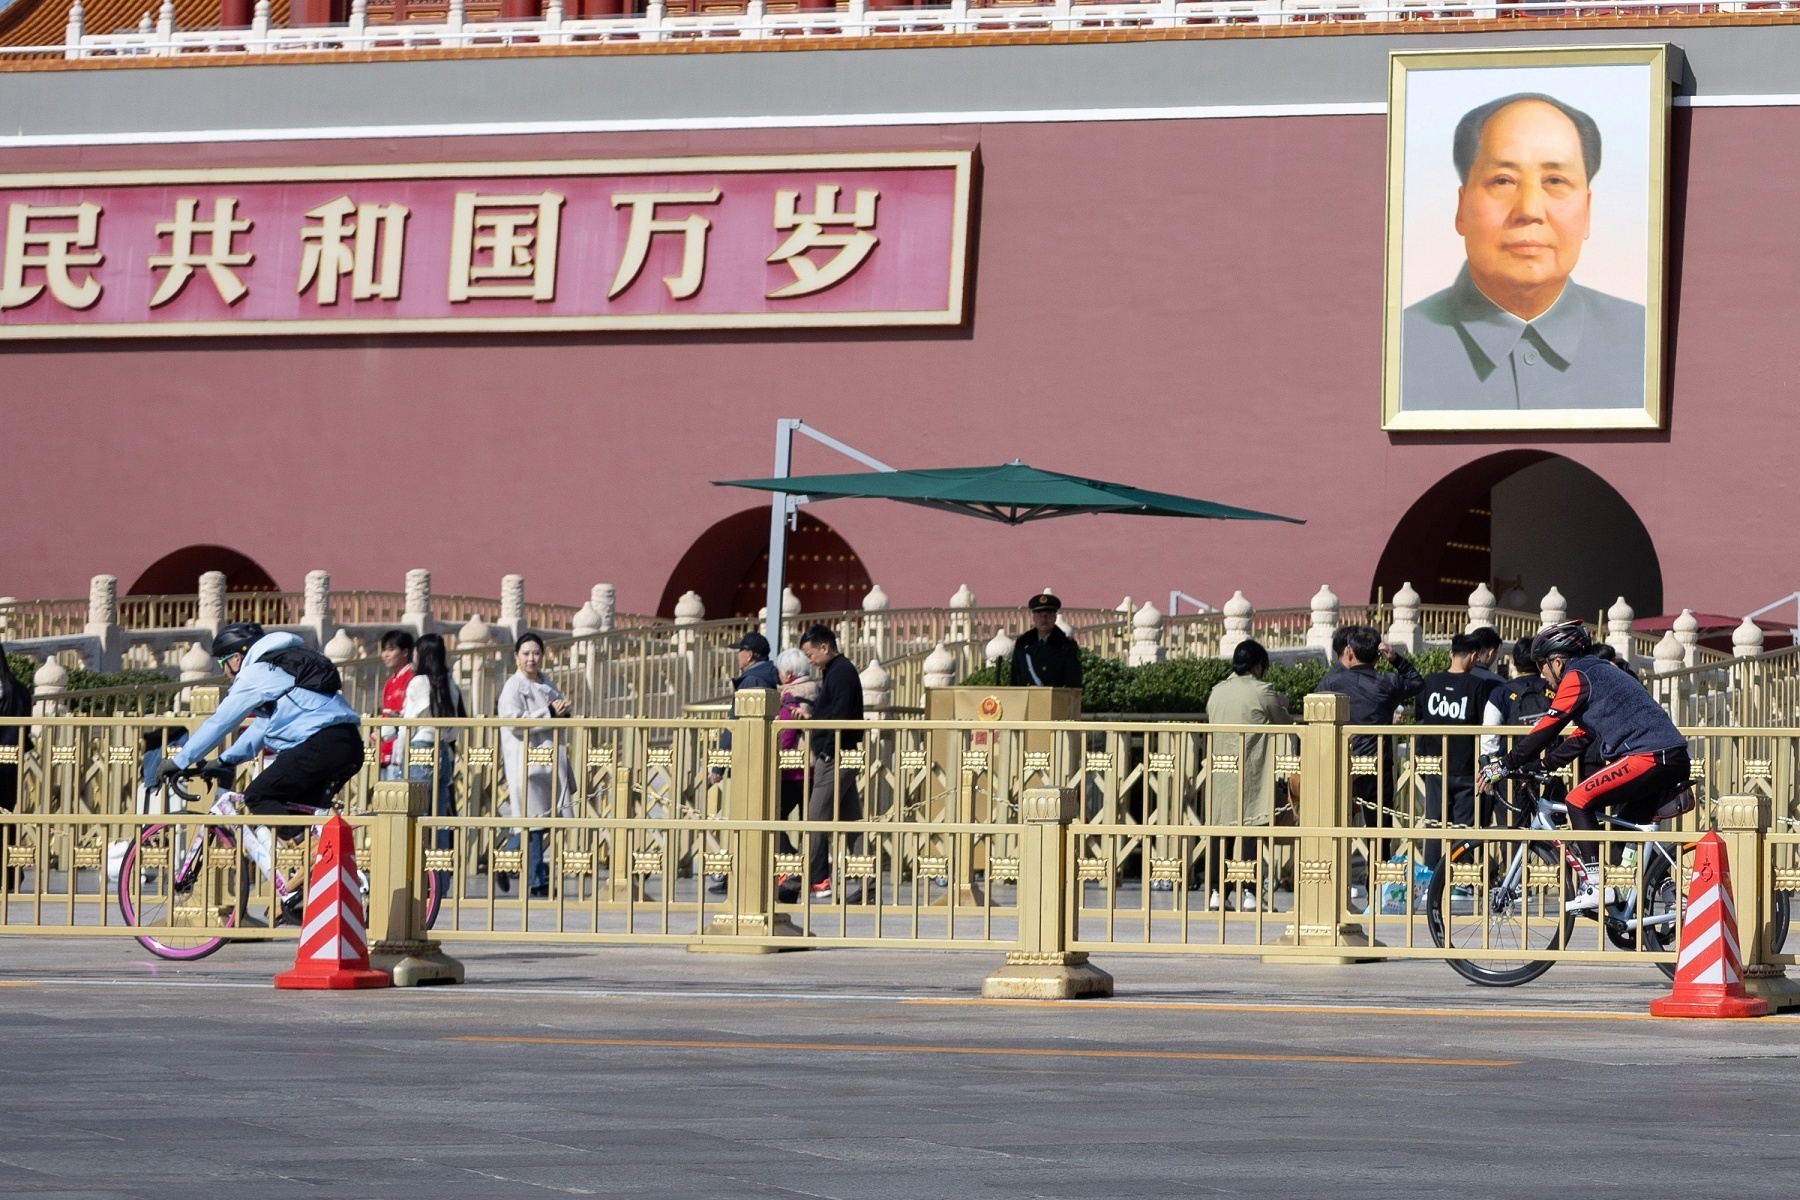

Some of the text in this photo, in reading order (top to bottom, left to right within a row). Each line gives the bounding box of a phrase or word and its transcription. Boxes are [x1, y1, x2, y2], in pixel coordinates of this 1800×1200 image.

[0, 185, 880, 309] 民共和国万岁
[1428, 692, 1468, 720] Cool
[1585, 763, 1629, 791] GIANT
